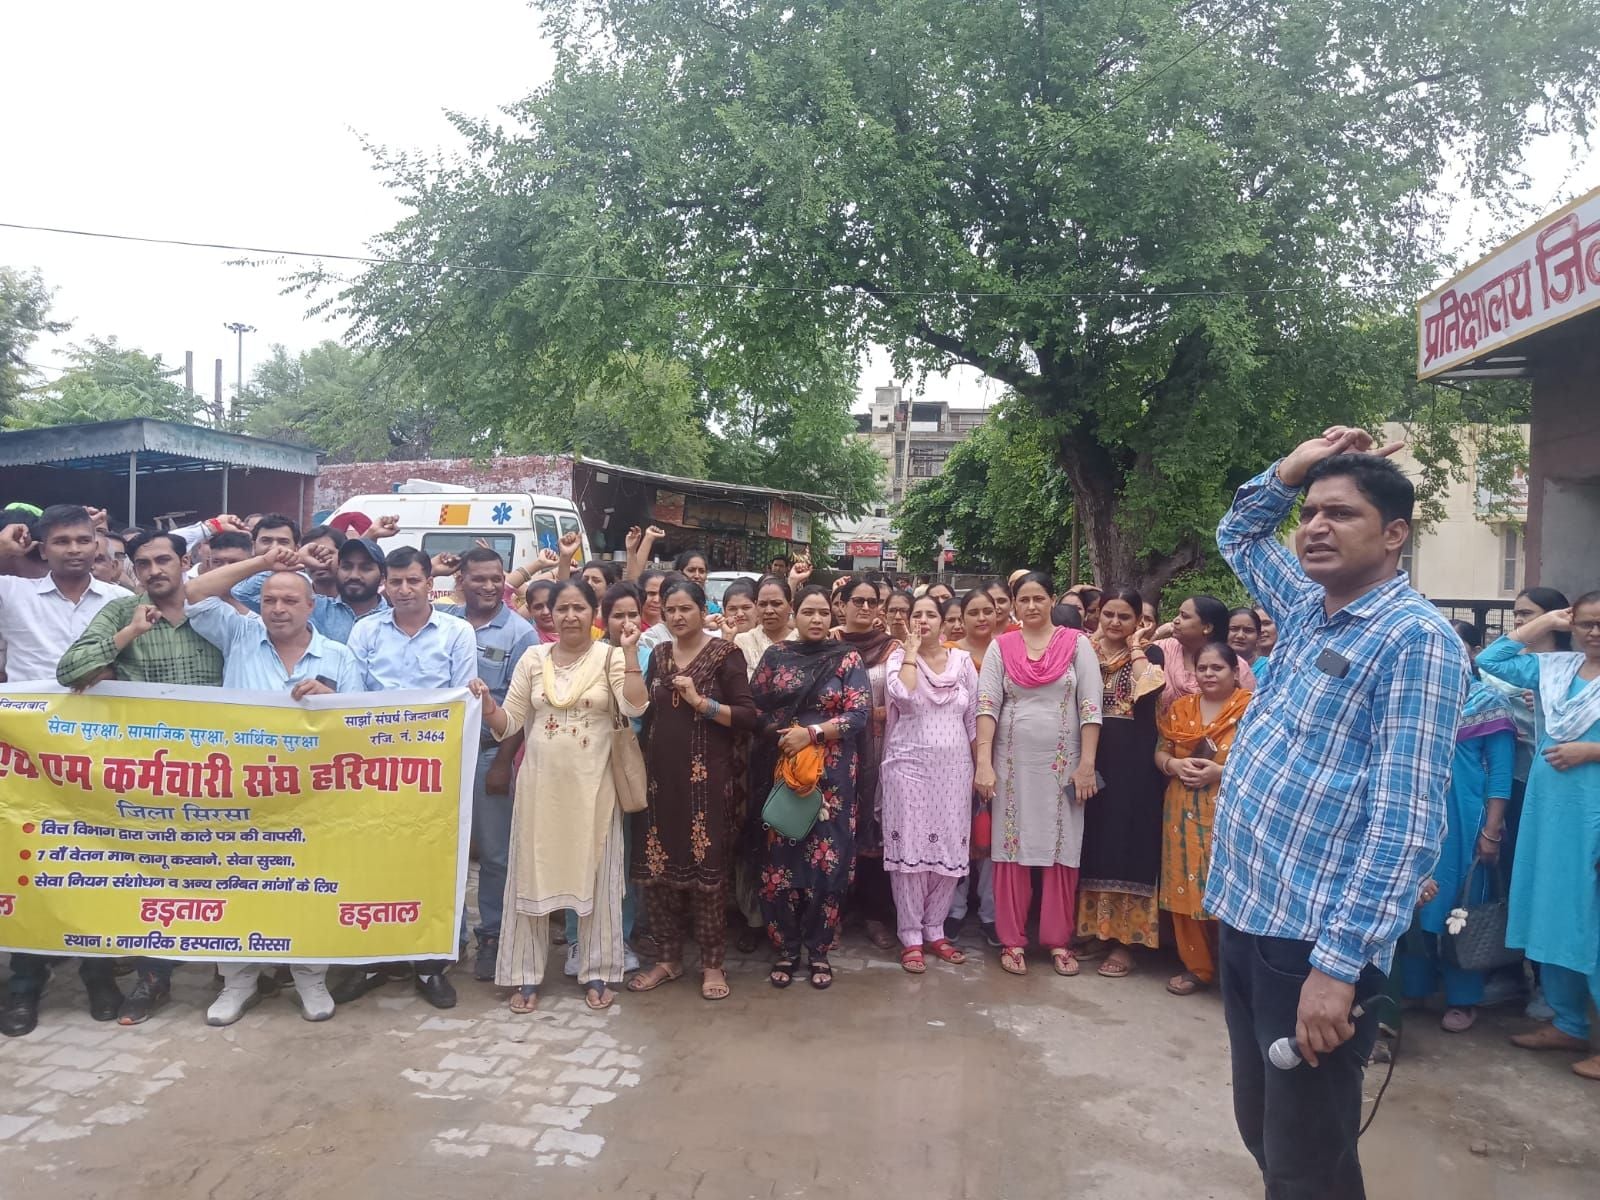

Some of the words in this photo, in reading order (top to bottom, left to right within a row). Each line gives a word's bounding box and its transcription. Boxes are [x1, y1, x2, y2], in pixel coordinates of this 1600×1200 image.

[1424, 259, 1533, 368] प्रतिक्षालय
[375, 711, 400, 725] संघर्ष
[404, 708, 449, 722] जिन्दाबाद
[48, 716, 76, 734] सेवा
[81, 723, 123, 740] सुरक्षा,
[128, 723, 185, 740] सामाजिक
[189, 729, 228, 747] सुरक्षा,
[234, 729, 278, 746] आर्थिक
[282, 735, 319, 751] सुरक्षा
[370, 732, 395, 745] रजि.
[400, 730, 412, 742] नं.
[417, 731, 445, 742] 3464
[104, 749, 233, 798] कर्मचारी
[243, 755, 300, 798] संघ
[310, 753, 442, 793] हरियाणा
[117, 800, 175, 820] जिला
[182, 803, 251, 821] सिरसा
[41, 819, 69, 835] वित्त
[73, 822, 115, 837] विभाग
[119, 828, 142, 840] द्वारा
[147, 828, 177, 842] जारी
[180, 828, 213, 842] काले
[216, 831, 236, 842] पत्र
[240, 828, 259, 842] की
[262, 828, 306, 843] वापसी,
[37, 850, 45, 860] 7
[70, 847, 103, 861] वेतन
[107, 850, 135, 862] मान
[139, 853, 170, 869] लागू
[227, 852, 253, 866] सेवा
[256, 855, 295, 870] सुरक्षा,
[34, 872, 63, 887] सेवा
[68, 872, 108, 887] नियम
[112, 873, 165, 888] संशोधन
[168, 879, 179, 889] व
[182, 879, 212, 890] अन्य
[216, 876, 258, 891] लम्बित
[261, 877, 296, 892] मांगों
[296, 879, 310, 892] के
[314, 878, 338, 893] लिए
[140, 898, 227, 927] हड़ताल
[339, 901, 421, 930] हड़ताल
[64, 933, 102, 948] स्थान
[116, 931, 176, 950] नागरिक
[248, 932, 291, 951] सिरसा
